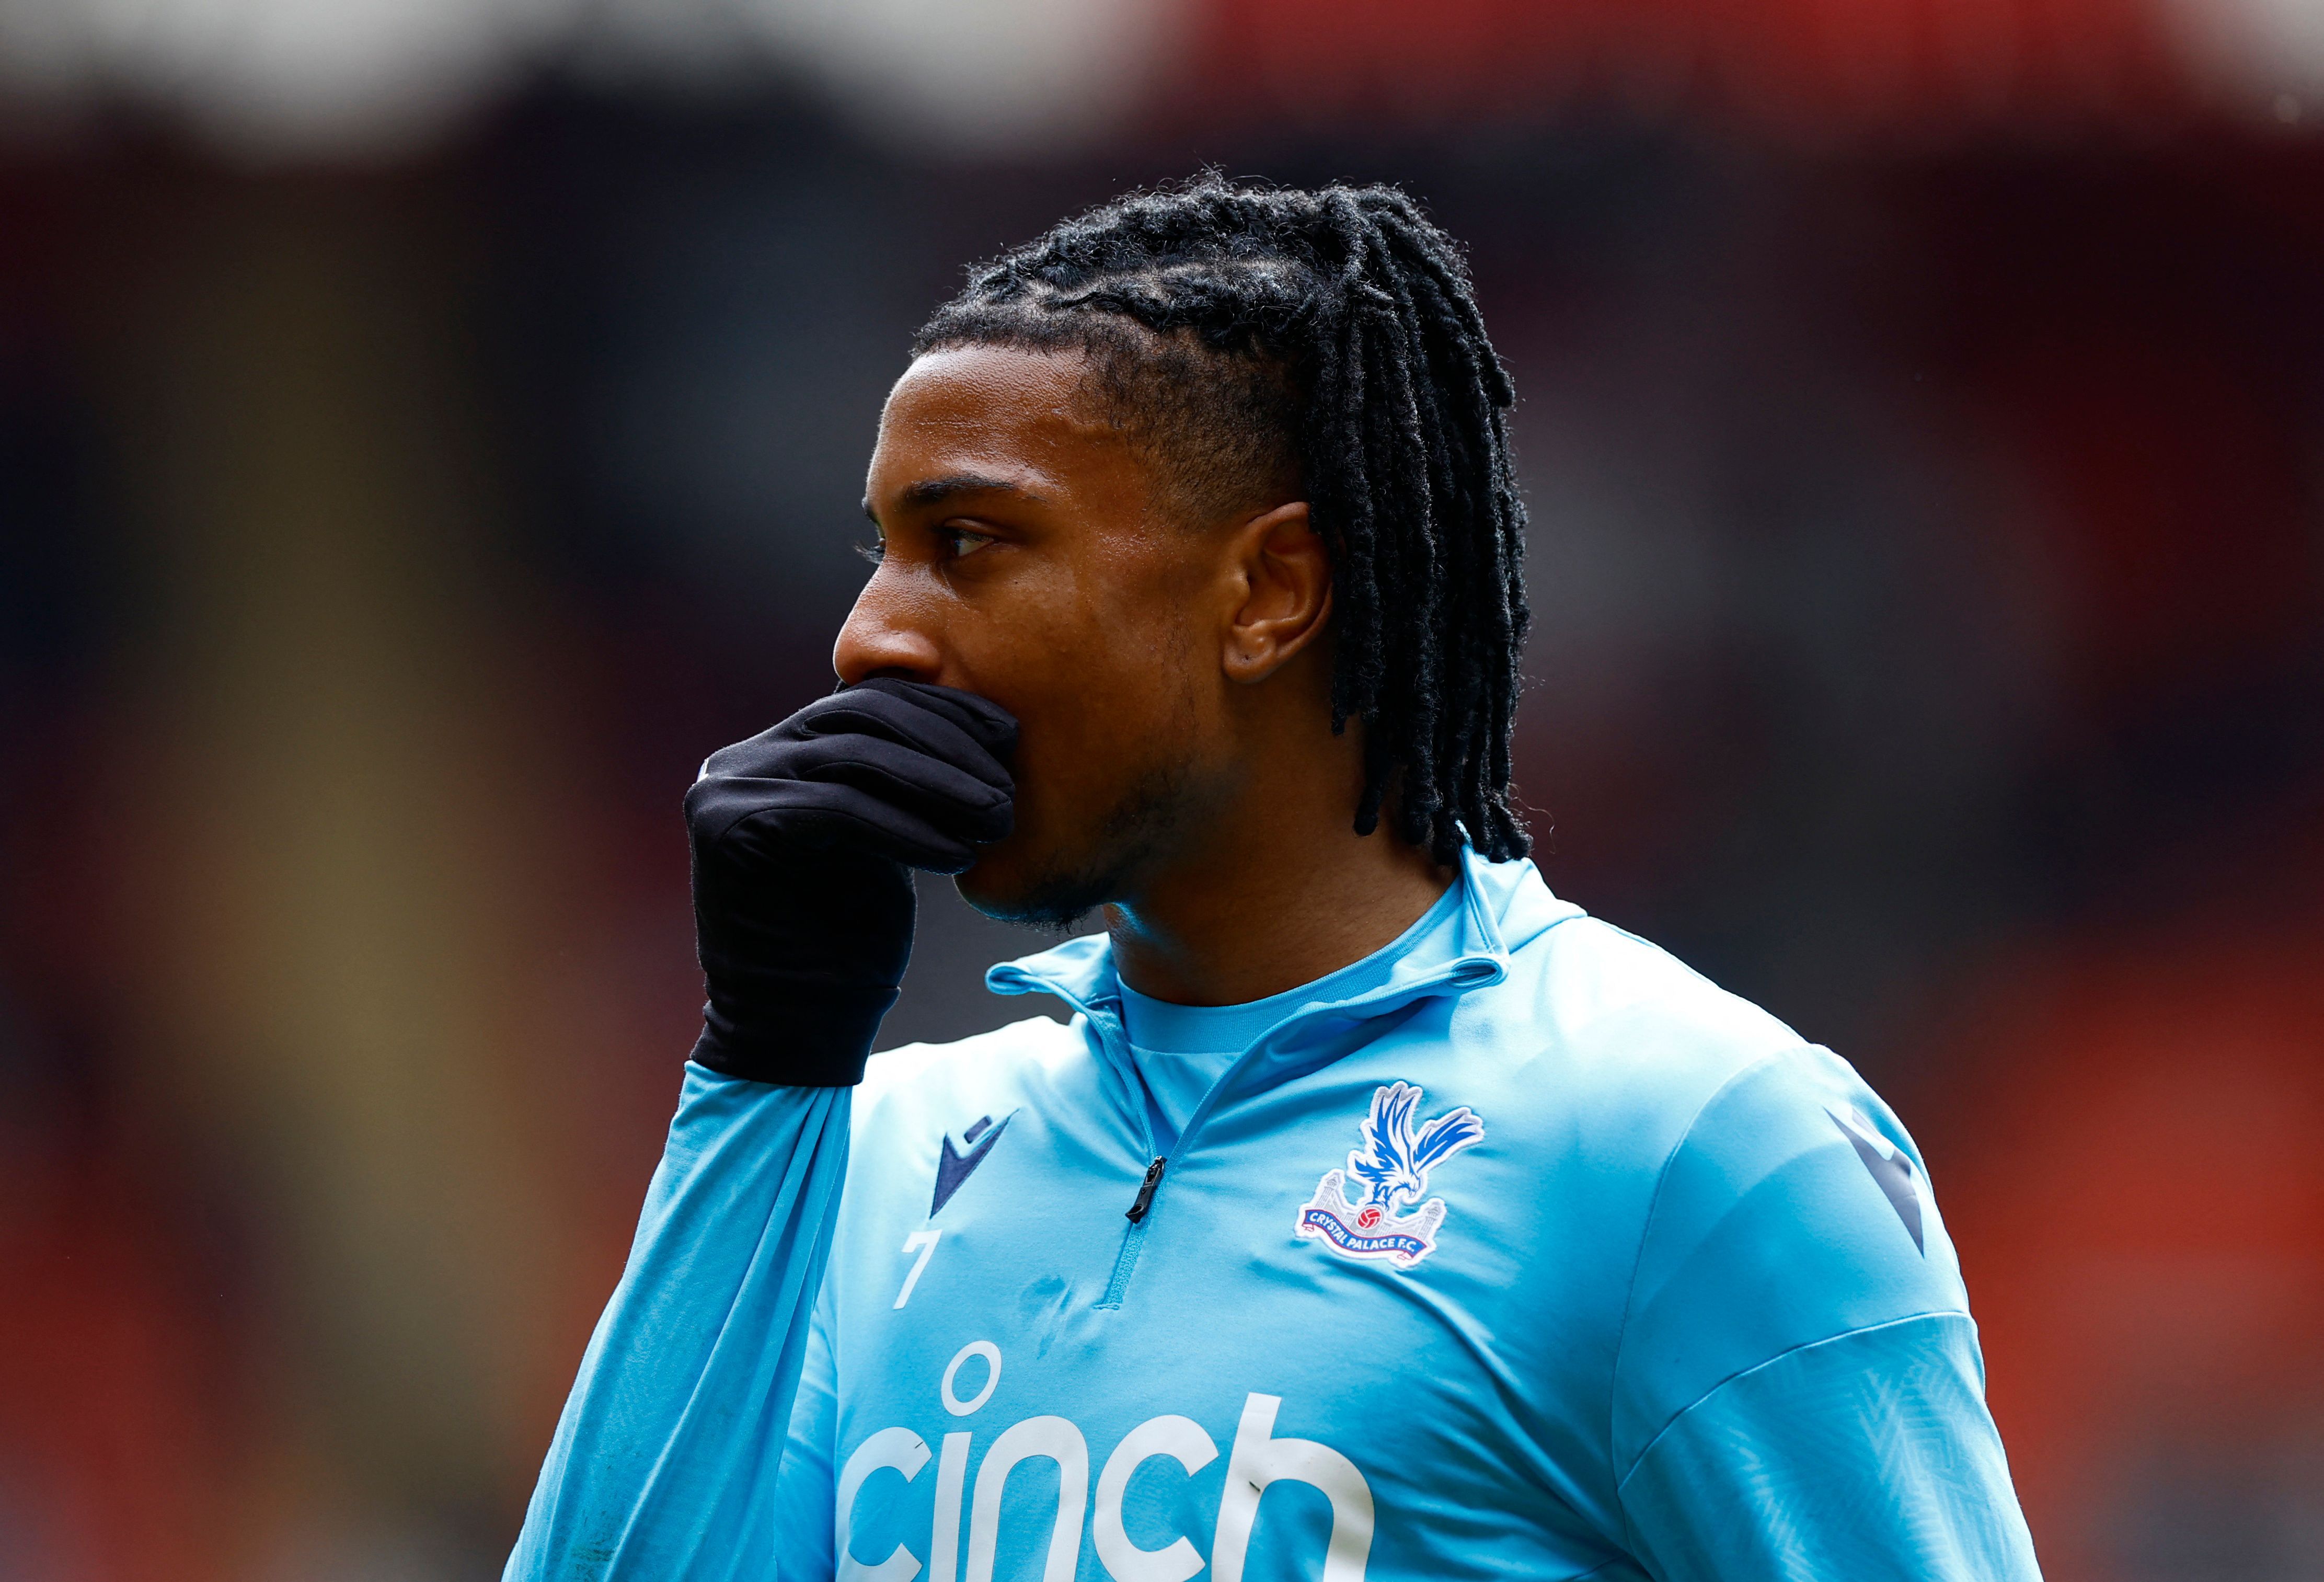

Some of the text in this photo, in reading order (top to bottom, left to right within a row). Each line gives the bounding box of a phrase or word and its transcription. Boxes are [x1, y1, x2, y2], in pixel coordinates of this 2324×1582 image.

[893, 1229, 942, 1310] 7
[1309, 1212, 1417, 1252] CRYSTAL PALACE F.C.
[836, 1340, 1375, 1582] cinch
